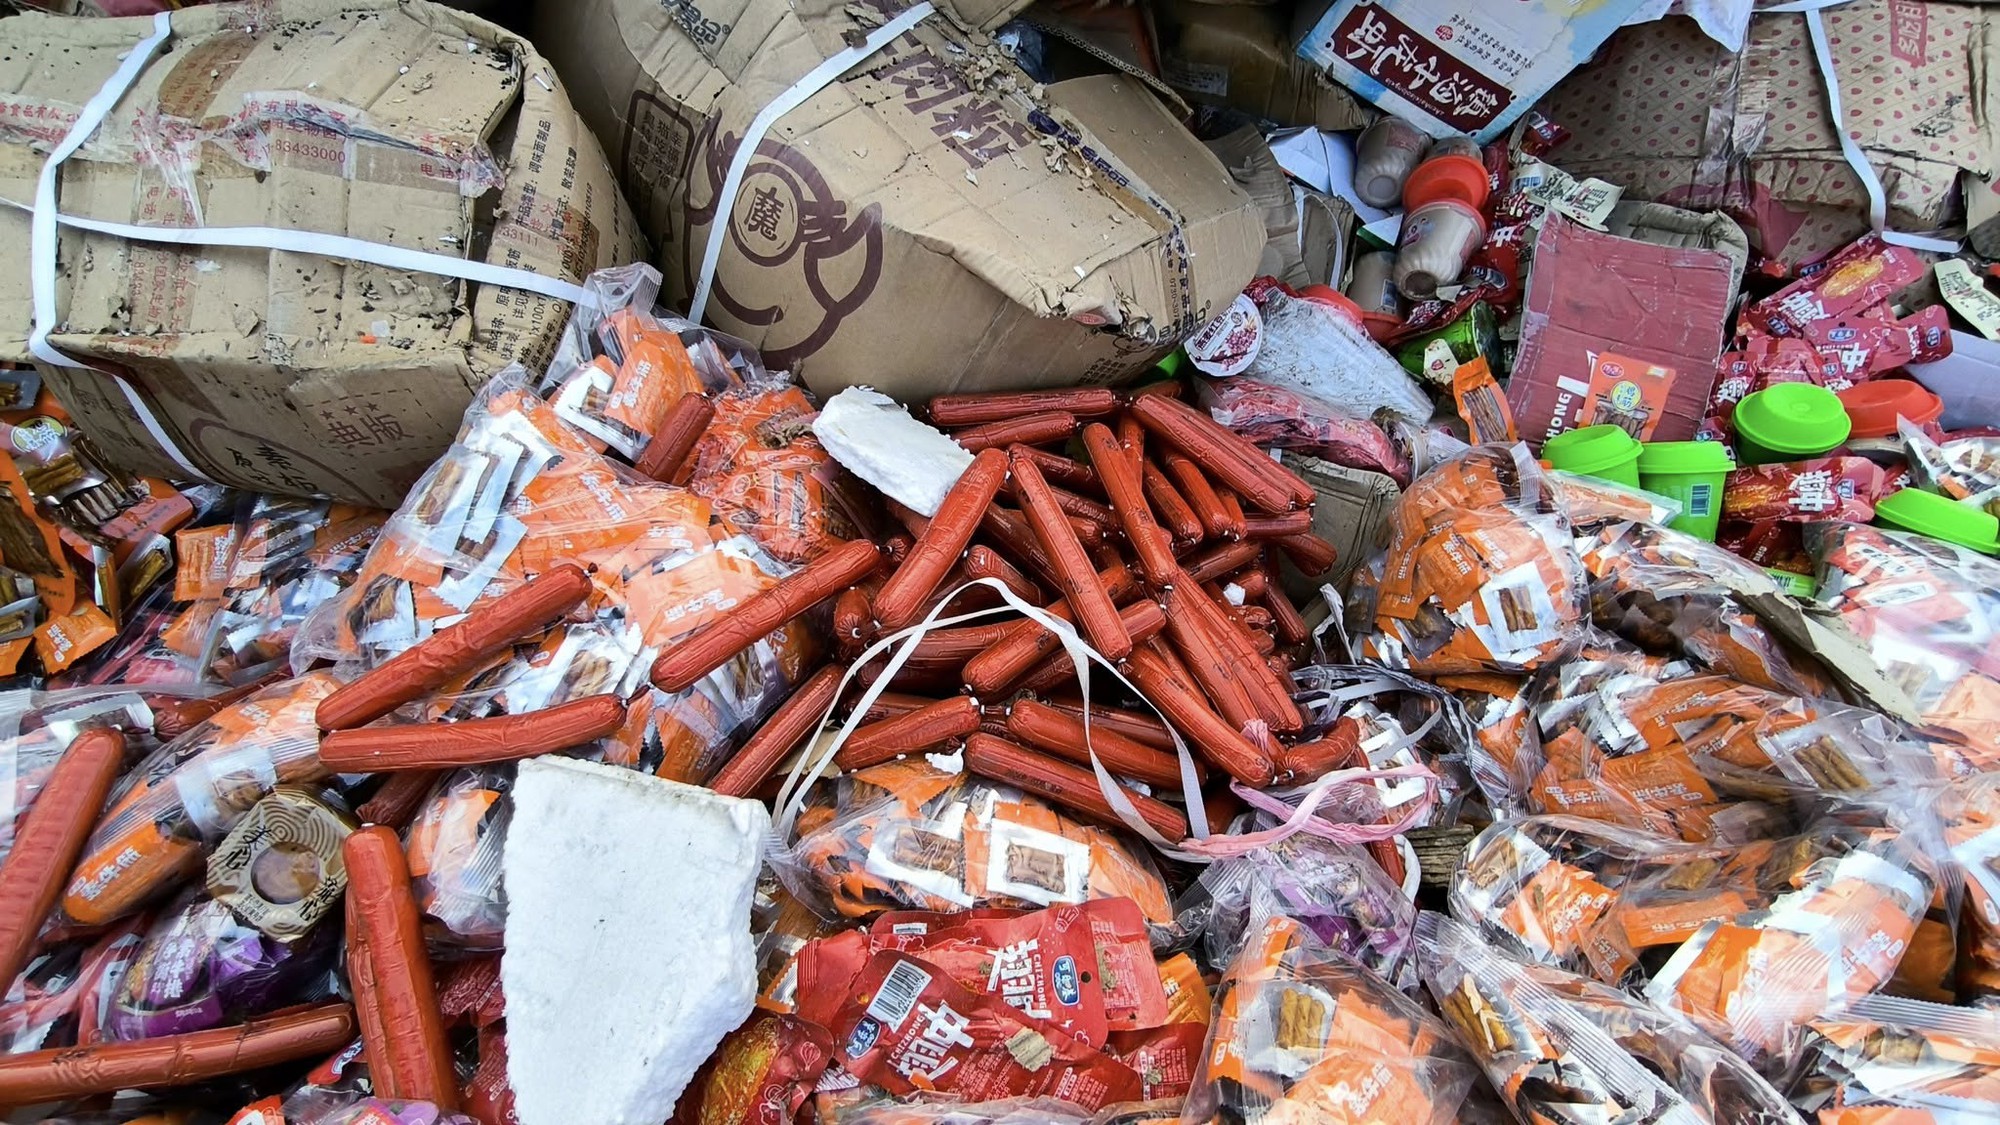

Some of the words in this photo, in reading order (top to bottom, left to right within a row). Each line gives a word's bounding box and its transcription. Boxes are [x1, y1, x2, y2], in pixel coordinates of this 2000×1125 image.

[1347, 10, 1499, 118] 镇海小龙虾
[743, 186, 780, 242] 魔
[1032, 953, 1048, 1010] CHIZHONG
[890, 1014, 927, 1062] CHIZHONG
